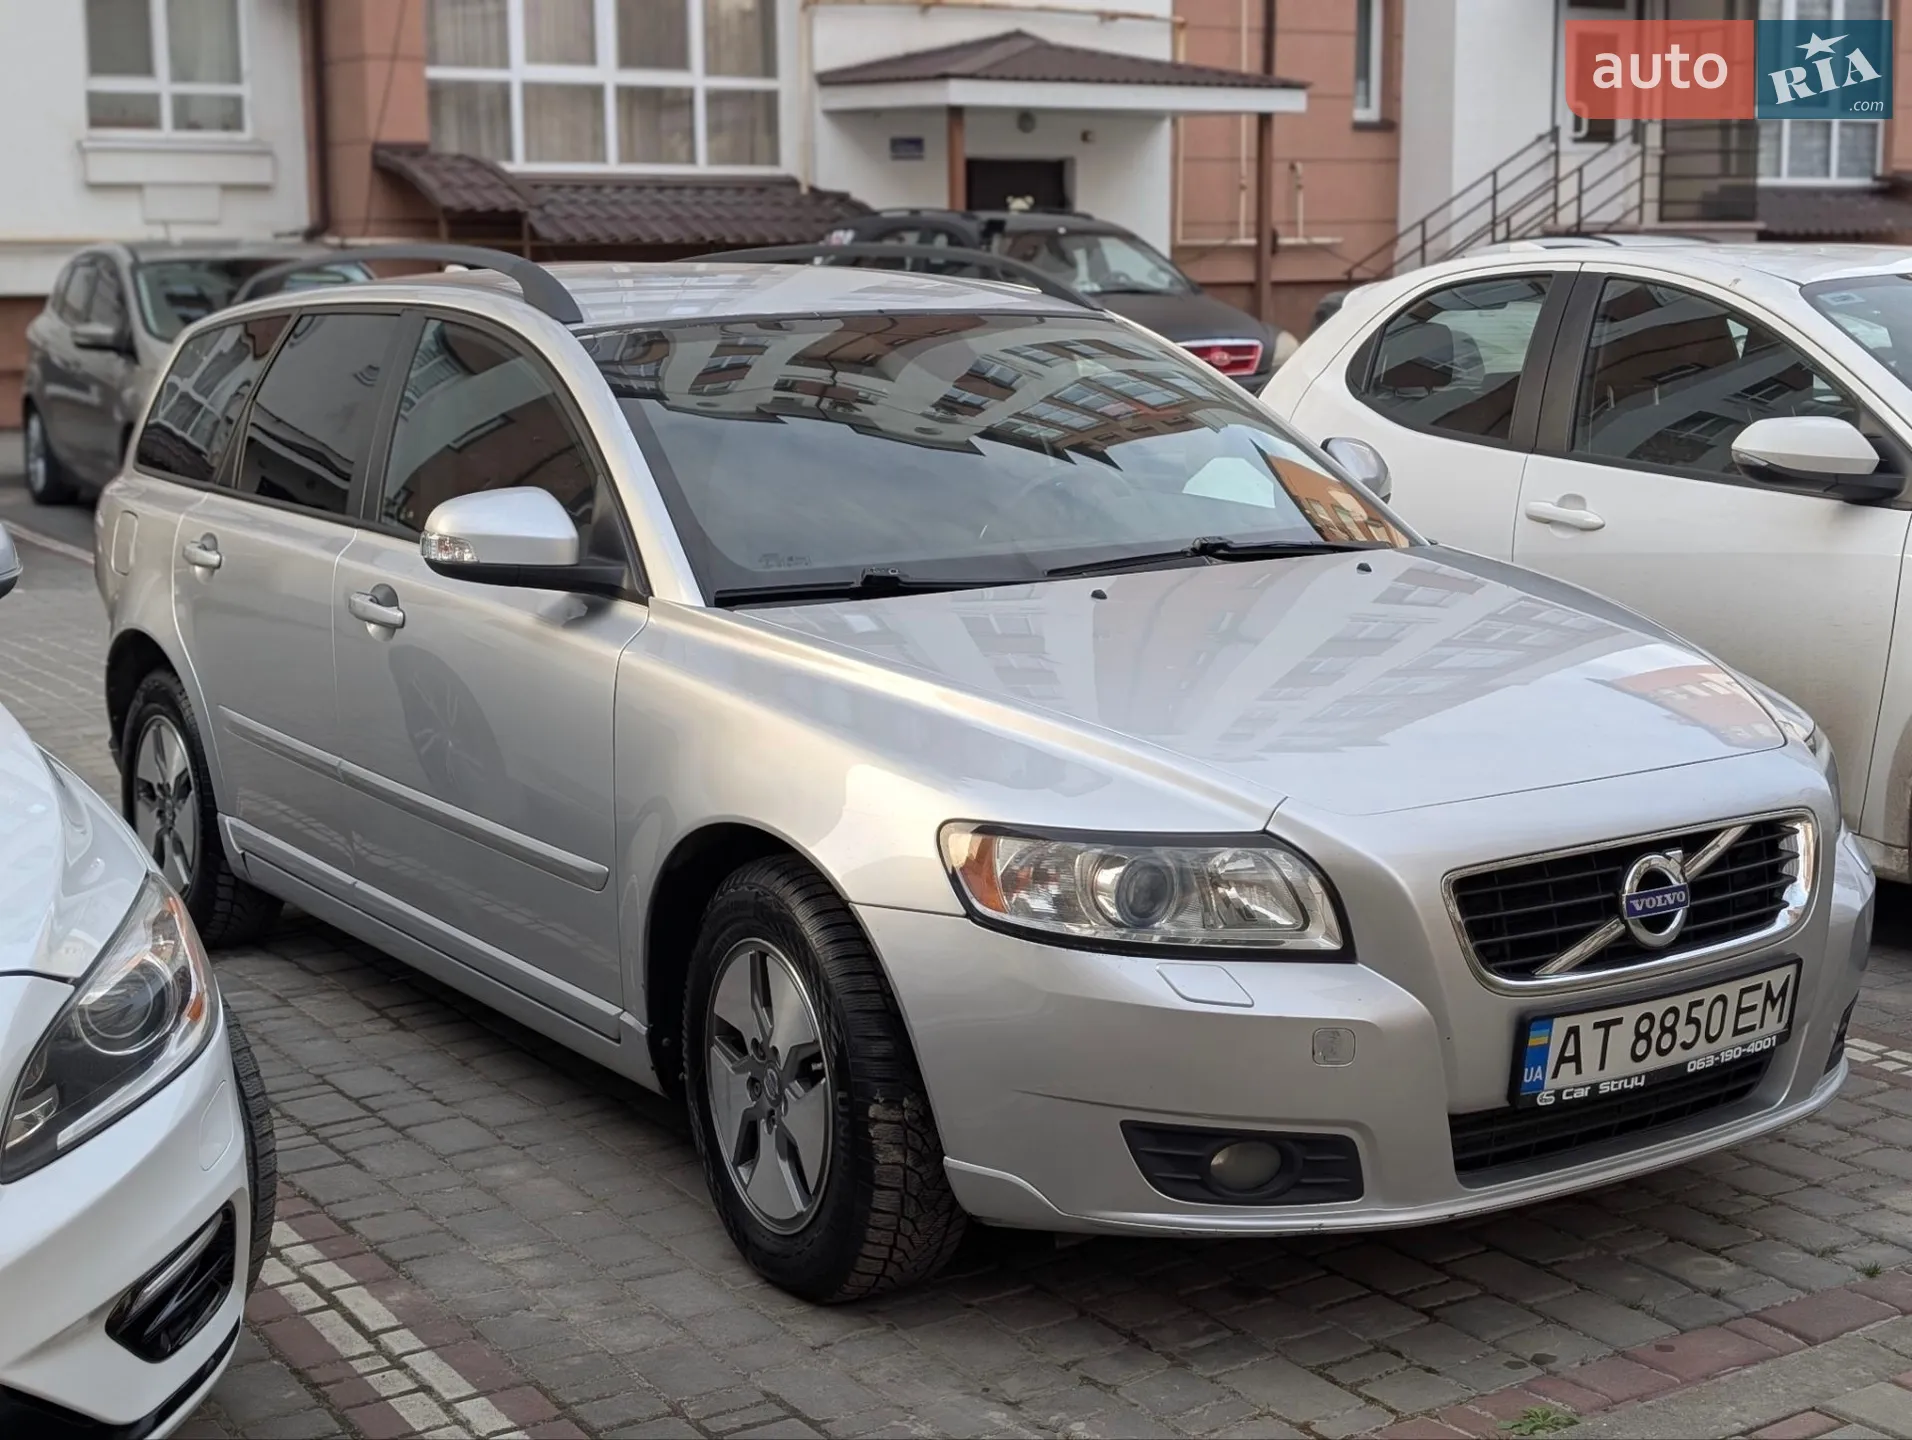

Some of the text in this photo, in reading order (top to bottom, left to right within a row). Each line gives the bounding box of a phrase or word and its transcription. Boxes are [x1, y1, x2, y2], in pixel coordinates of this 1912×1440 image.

[1630, 891, 1685, 911] VOLVO
[1551, 973, 1791, 1079] AT 8850 EM
[1687, 1035, 1777, 1073] 063-190-4001
[1523, 1067, 1543, 1083] UA
[1562, 1086, 1591, 1100] Car
